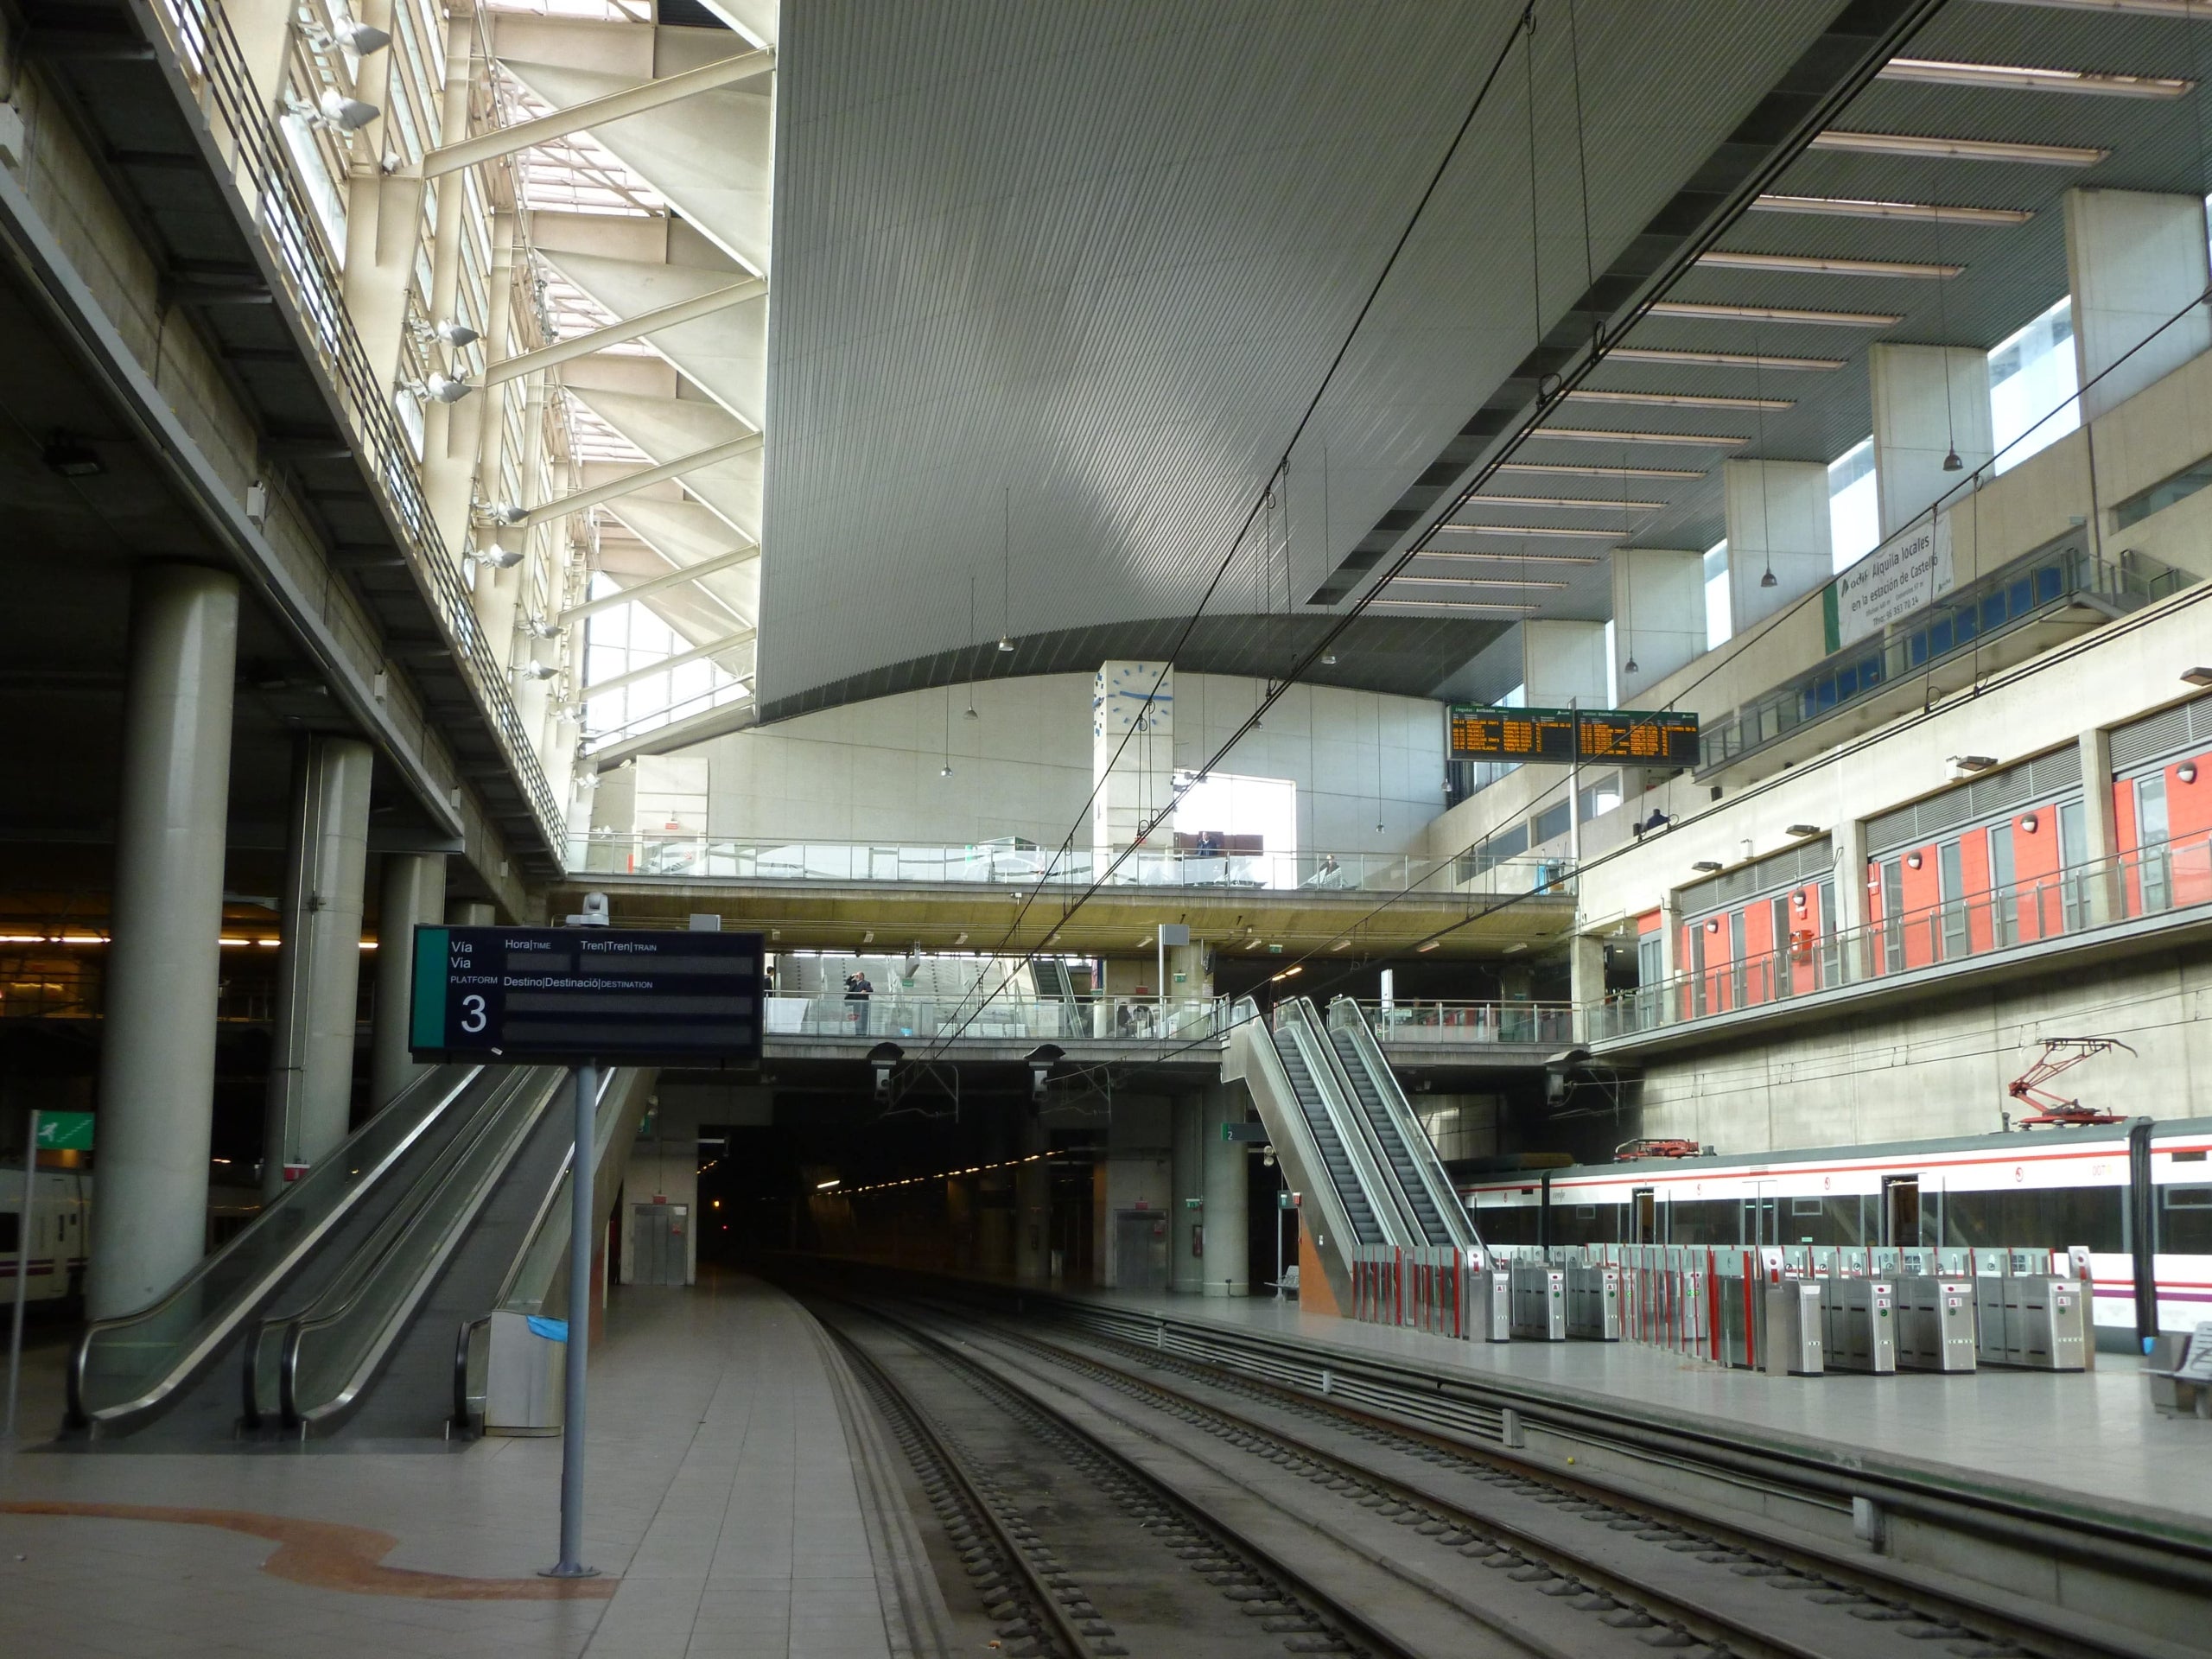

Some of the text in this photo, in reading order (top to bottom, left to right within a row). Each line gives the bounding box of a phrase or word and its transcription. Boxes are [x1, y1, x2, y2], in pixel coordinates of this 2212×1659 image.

[1872, 553, 1899, 579] Alquila
[1901, 535, 1929, 561] locales
[1852, 601, 1861, 612] en
[1862, 594, 1868, 607] la
[1870, 576, 1899, 601] estación
[1900, 571, 1909, 585] de
[451, 941, 473, 953] Vía
[450, 957, 471, 969] Via
[450, 976, 498, 984] PLATFORM
[461, 995, 486, 1033] 3
[1227, 1131, 1234, 1141] 2
